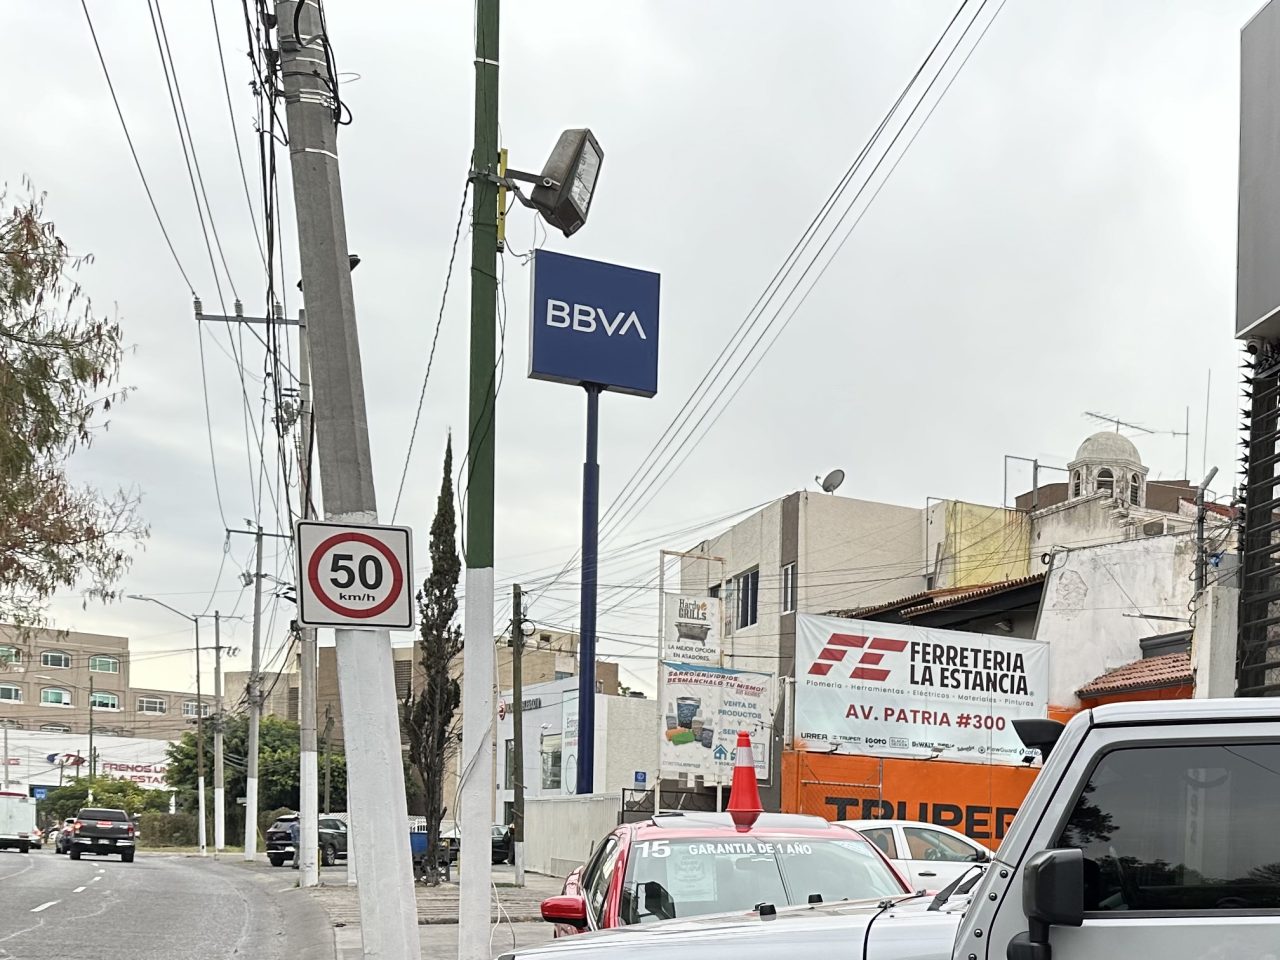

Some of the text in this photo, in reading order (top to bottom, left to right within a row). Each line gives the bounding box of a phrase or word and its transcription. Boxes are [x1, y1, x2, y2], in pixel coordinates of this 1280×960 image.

[546, 299, 647, 340] BBVA
[330, 553, 383, 590] 50
[339, 592, 376, 601] km/h
[678, 608, 707, 620] GRILLS
[910, 641, 1025, 673] FERRETERIA
[910, 664, 1029, 696] LA ESTANCIA
[724, 700, 747, 708] VENTA
[851, 684, 905, 695] Herramientas
[958, 694, 997, 704] Materiales
[1004, 699, 1034, 707] Pinturas
[718, 709, 762, 718] PRODUCTOS
[845, 704, 1006, 731] AV. PATRIA #300
[801, 732, 828, 740] URREA
[102, 763, 152, 773] FRENOS
[635, 840, 812, 858] 15 GARANTIA DE 1 AÑO
